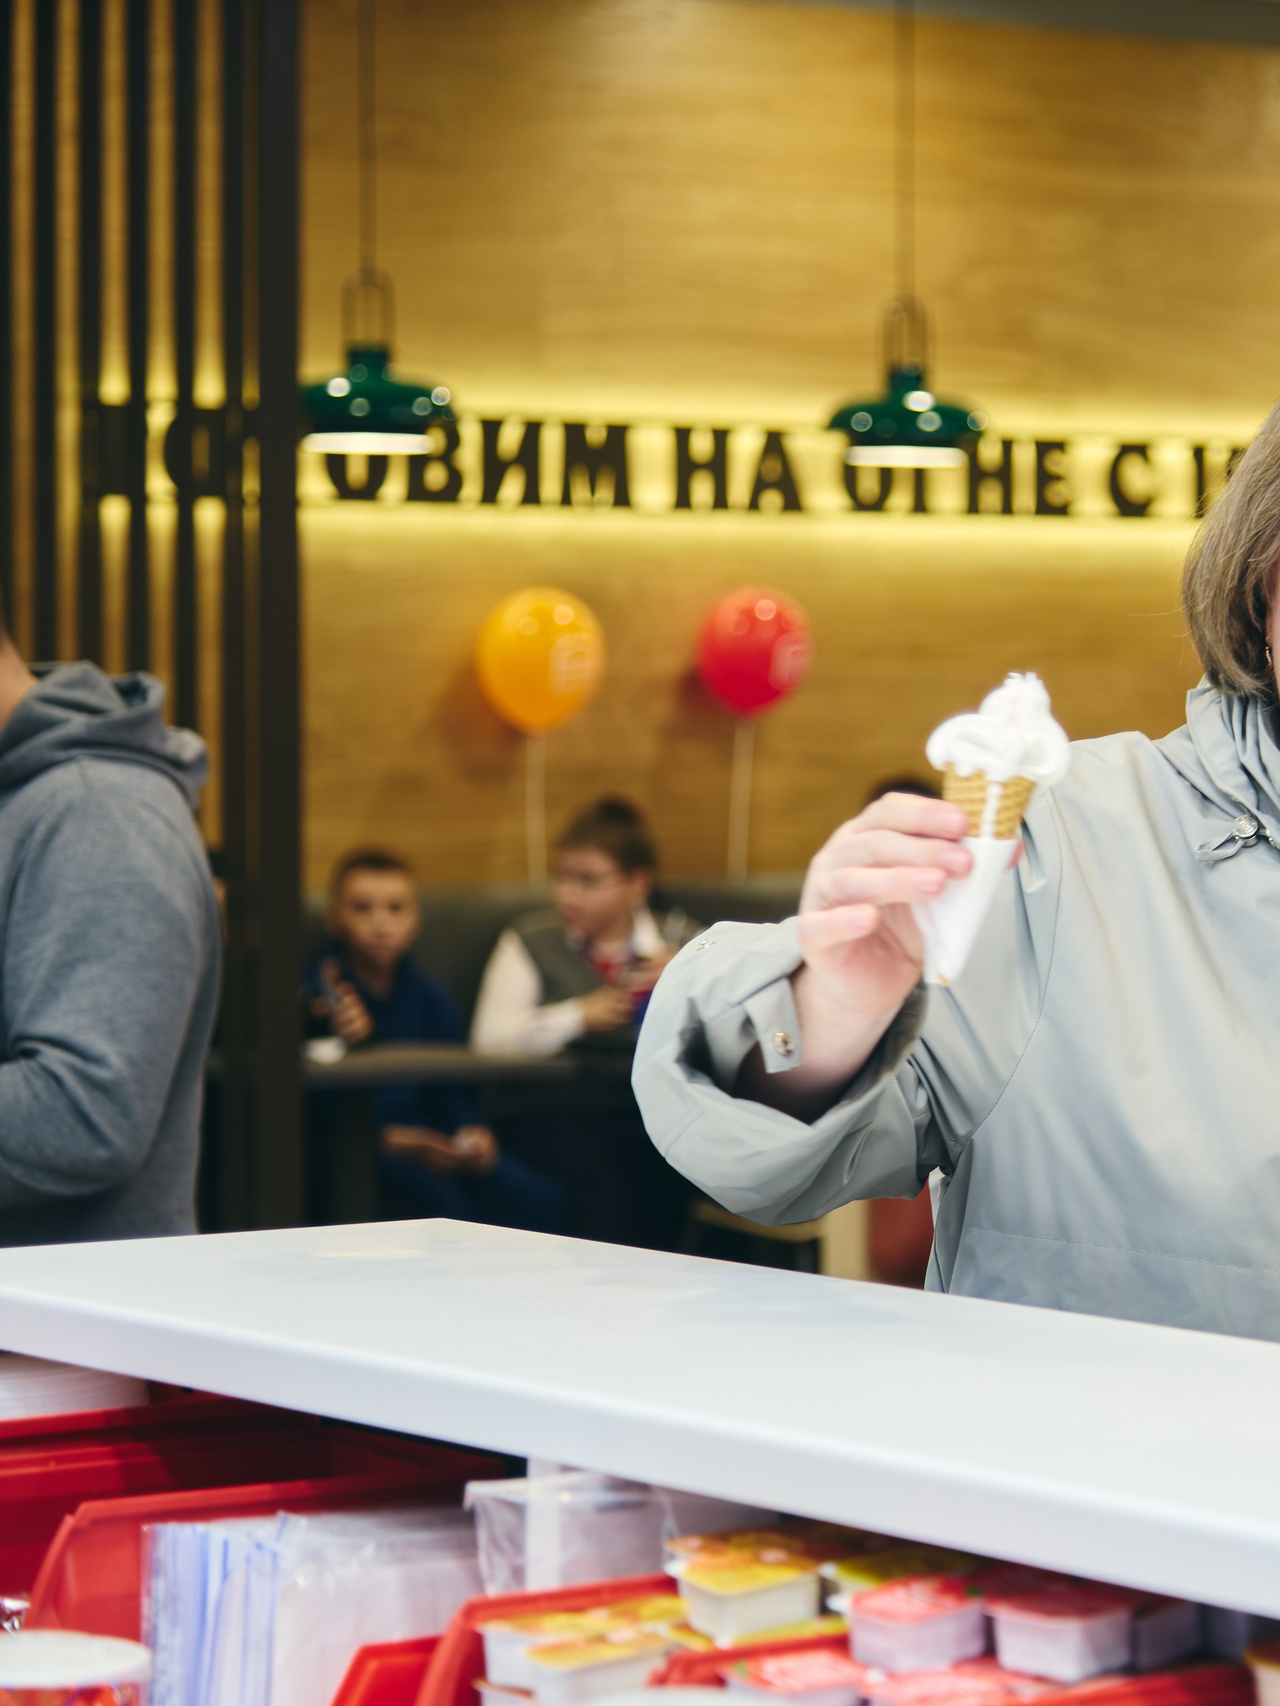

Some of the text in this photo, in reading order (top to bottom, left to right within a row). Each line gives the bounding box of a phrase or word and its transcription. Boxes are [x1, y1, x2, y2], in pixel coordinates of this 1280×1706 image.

[97, 405, 631, 508] ГООВИМ
[676, 427, 802, 511] НА
[1110, 443, 1151, 517] С
